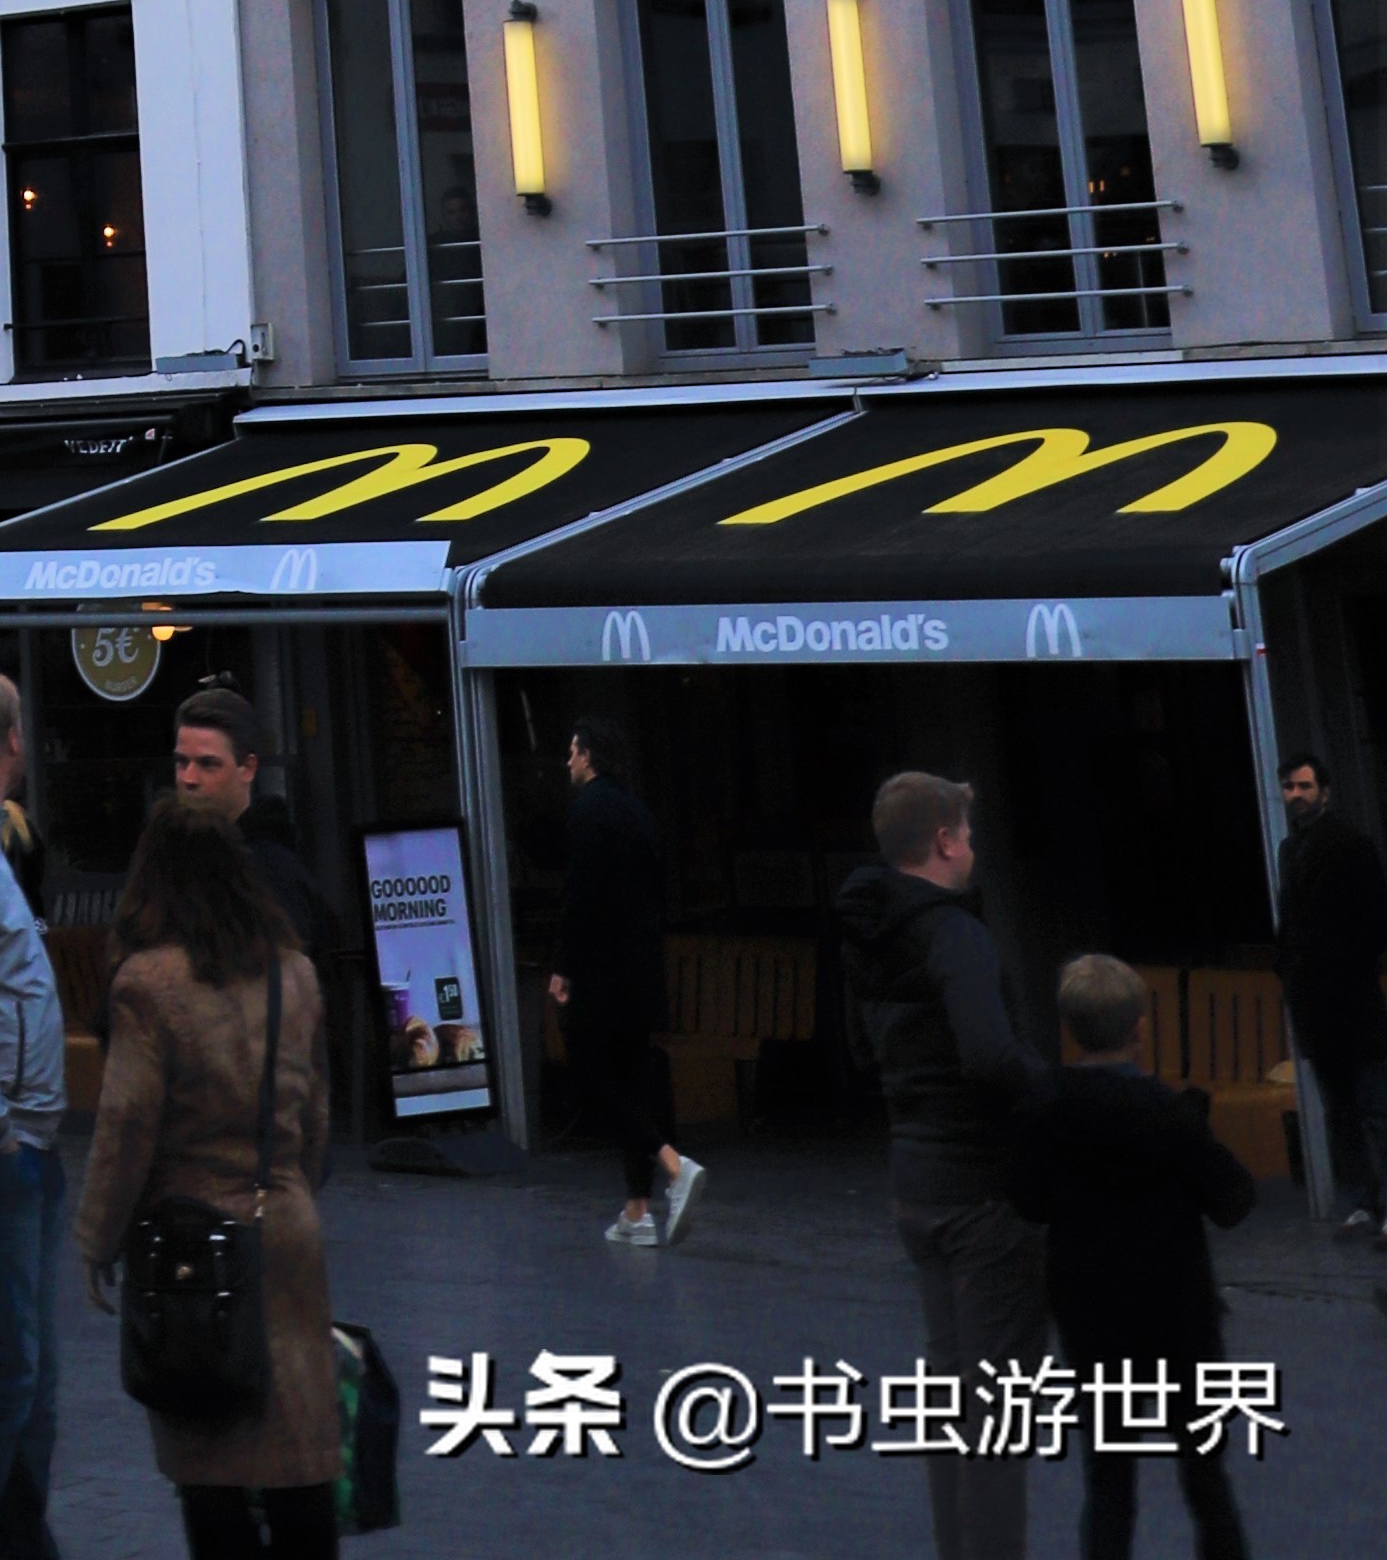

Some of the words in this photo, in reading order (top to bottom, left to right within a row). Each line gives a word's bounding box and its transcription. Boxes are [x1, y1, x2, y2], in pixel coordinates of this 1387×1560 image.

[23, 557, 217, 590] McDonald's
[92, 626, 139, 667] 5€
[716, 613, 950, 653] McDonald's
[371, 875, 451, 899] GOOOOOD
[373, 898, 447, 922] MORNING
